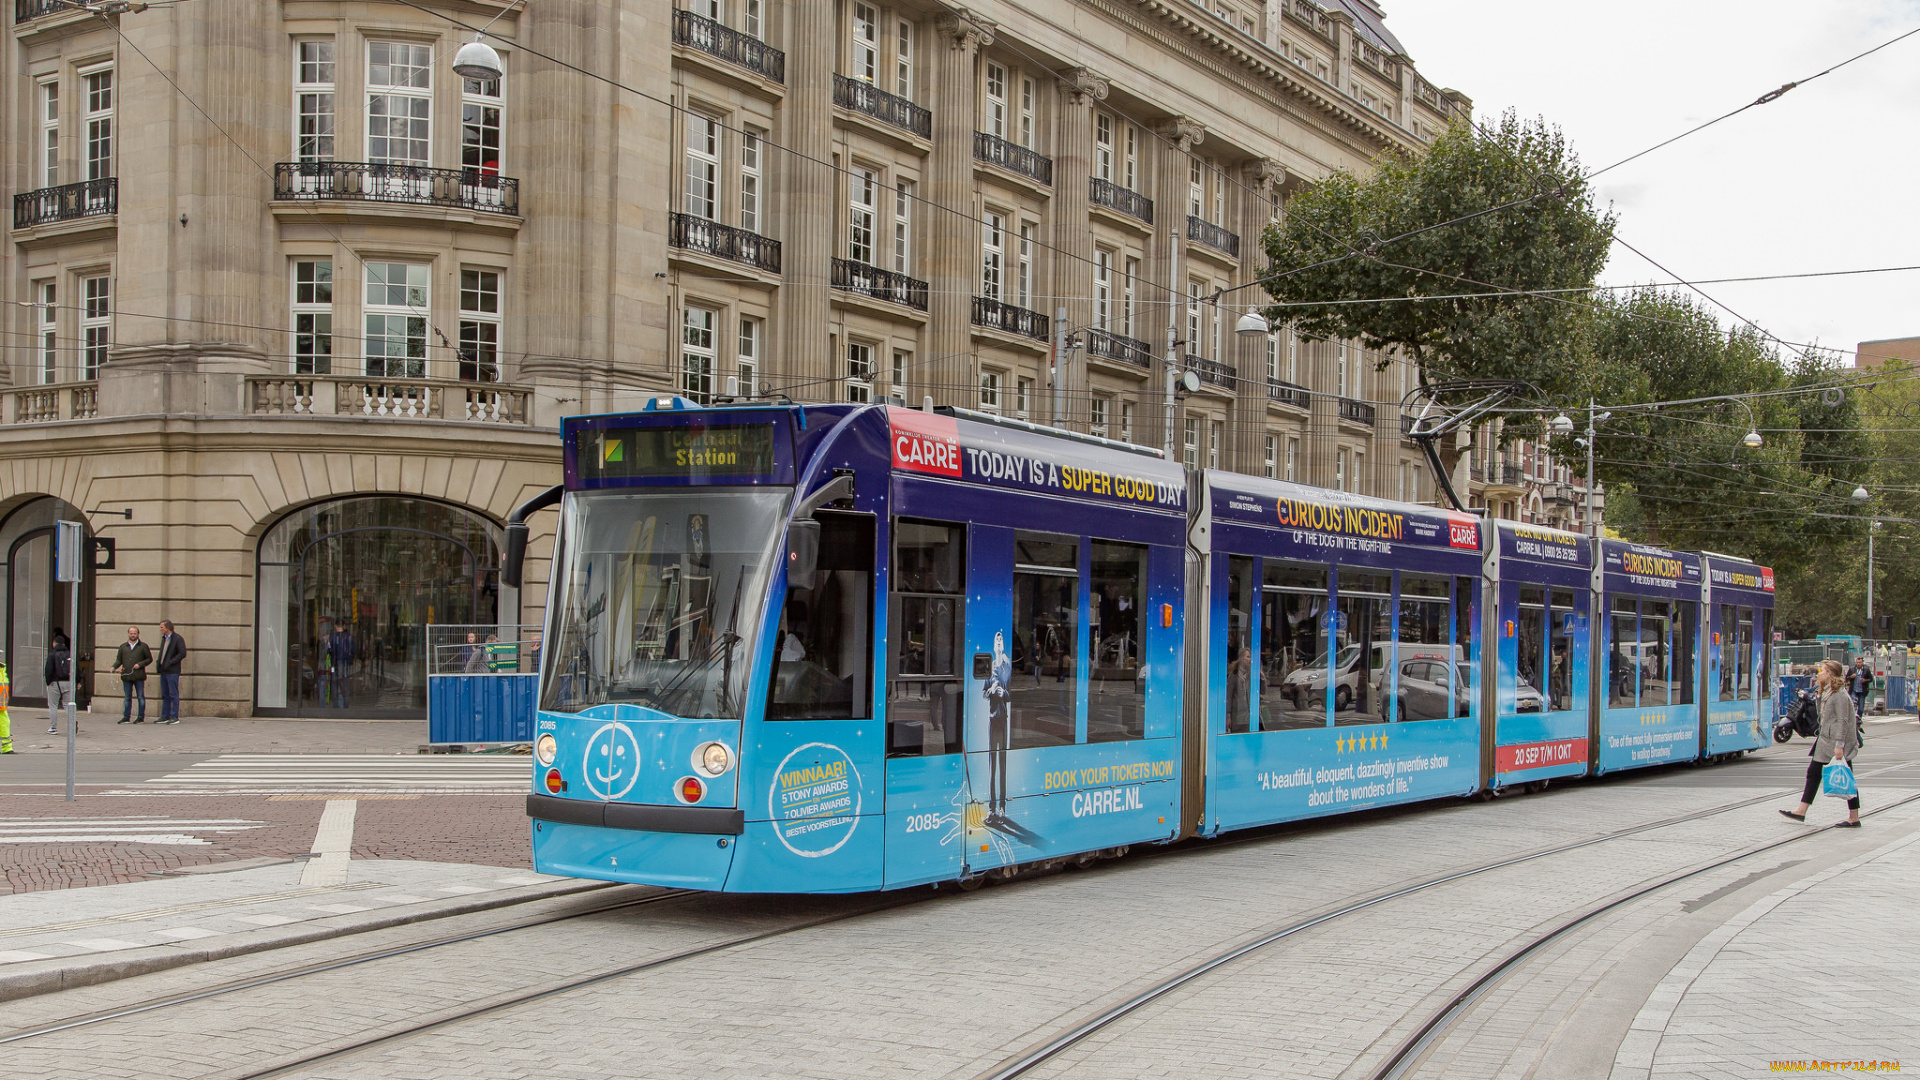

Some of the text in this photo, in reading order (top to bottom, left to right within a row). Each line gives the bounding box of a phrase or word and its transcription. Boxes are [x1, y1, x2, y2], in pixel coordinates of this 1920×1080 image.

[595, 433, 604, 469] 1
[676, 449, 736, 466] Station
[967, 448, 1182, 506] TODAY IS A SUPER GOOD DAY
[1277, 496, 1341, 532] CURIOUS
[1344, 507, 1403, 540] INCIDENT
[1293, 530, 1392, 554] OF THE DOG IN THE NIGHT-TIME
[1516, 541, 1542, 556] CARRE.NL
[1544, 545, 1555, 558] 0900
[1623, 552, 1683, 578] CURIOUS INCIDENT
[1711, 569, 1724, 582] TODAY
[1732, 572, 1745, 585] SUPER
[1745, 574, 1755, 587] GOOD
[540, 720, 556, 730] 2085
[1515, 743, 1572, 765] 20 SEP T/M 1 OKT
[779, 760, 847, 788] WINNAAR!
[1045, 760, 1174, 790] BOOK YOUR TICKETS NOW
[1272, 767, 1314, 790] beautiful,
[1316, 763, 1356, 787] eloquent,
[1356, 757, 1396, 779] dazzlingly
[1397, 754, 1429, 773] inventive
[1430, 753, 1449, 769] show
[1834, 773, 1845, 784] ah
[781, 779, 849, 804] 5 TONY AWARDS
[1072, 787, 1143, 818] CARRE.NL
[1308, 788, 1334, 807] about
[1335, 785, 1349, 804] the
[1350, 781, 1385, 801] wonders
[1386, 779, 1396, 797] of
[784, 797, 851, 819] 7 OLIVIER AWARDS
[785, 815, 853, 838] BESTE VOORSTELLING
[906, 812, 940, 833] 2085
